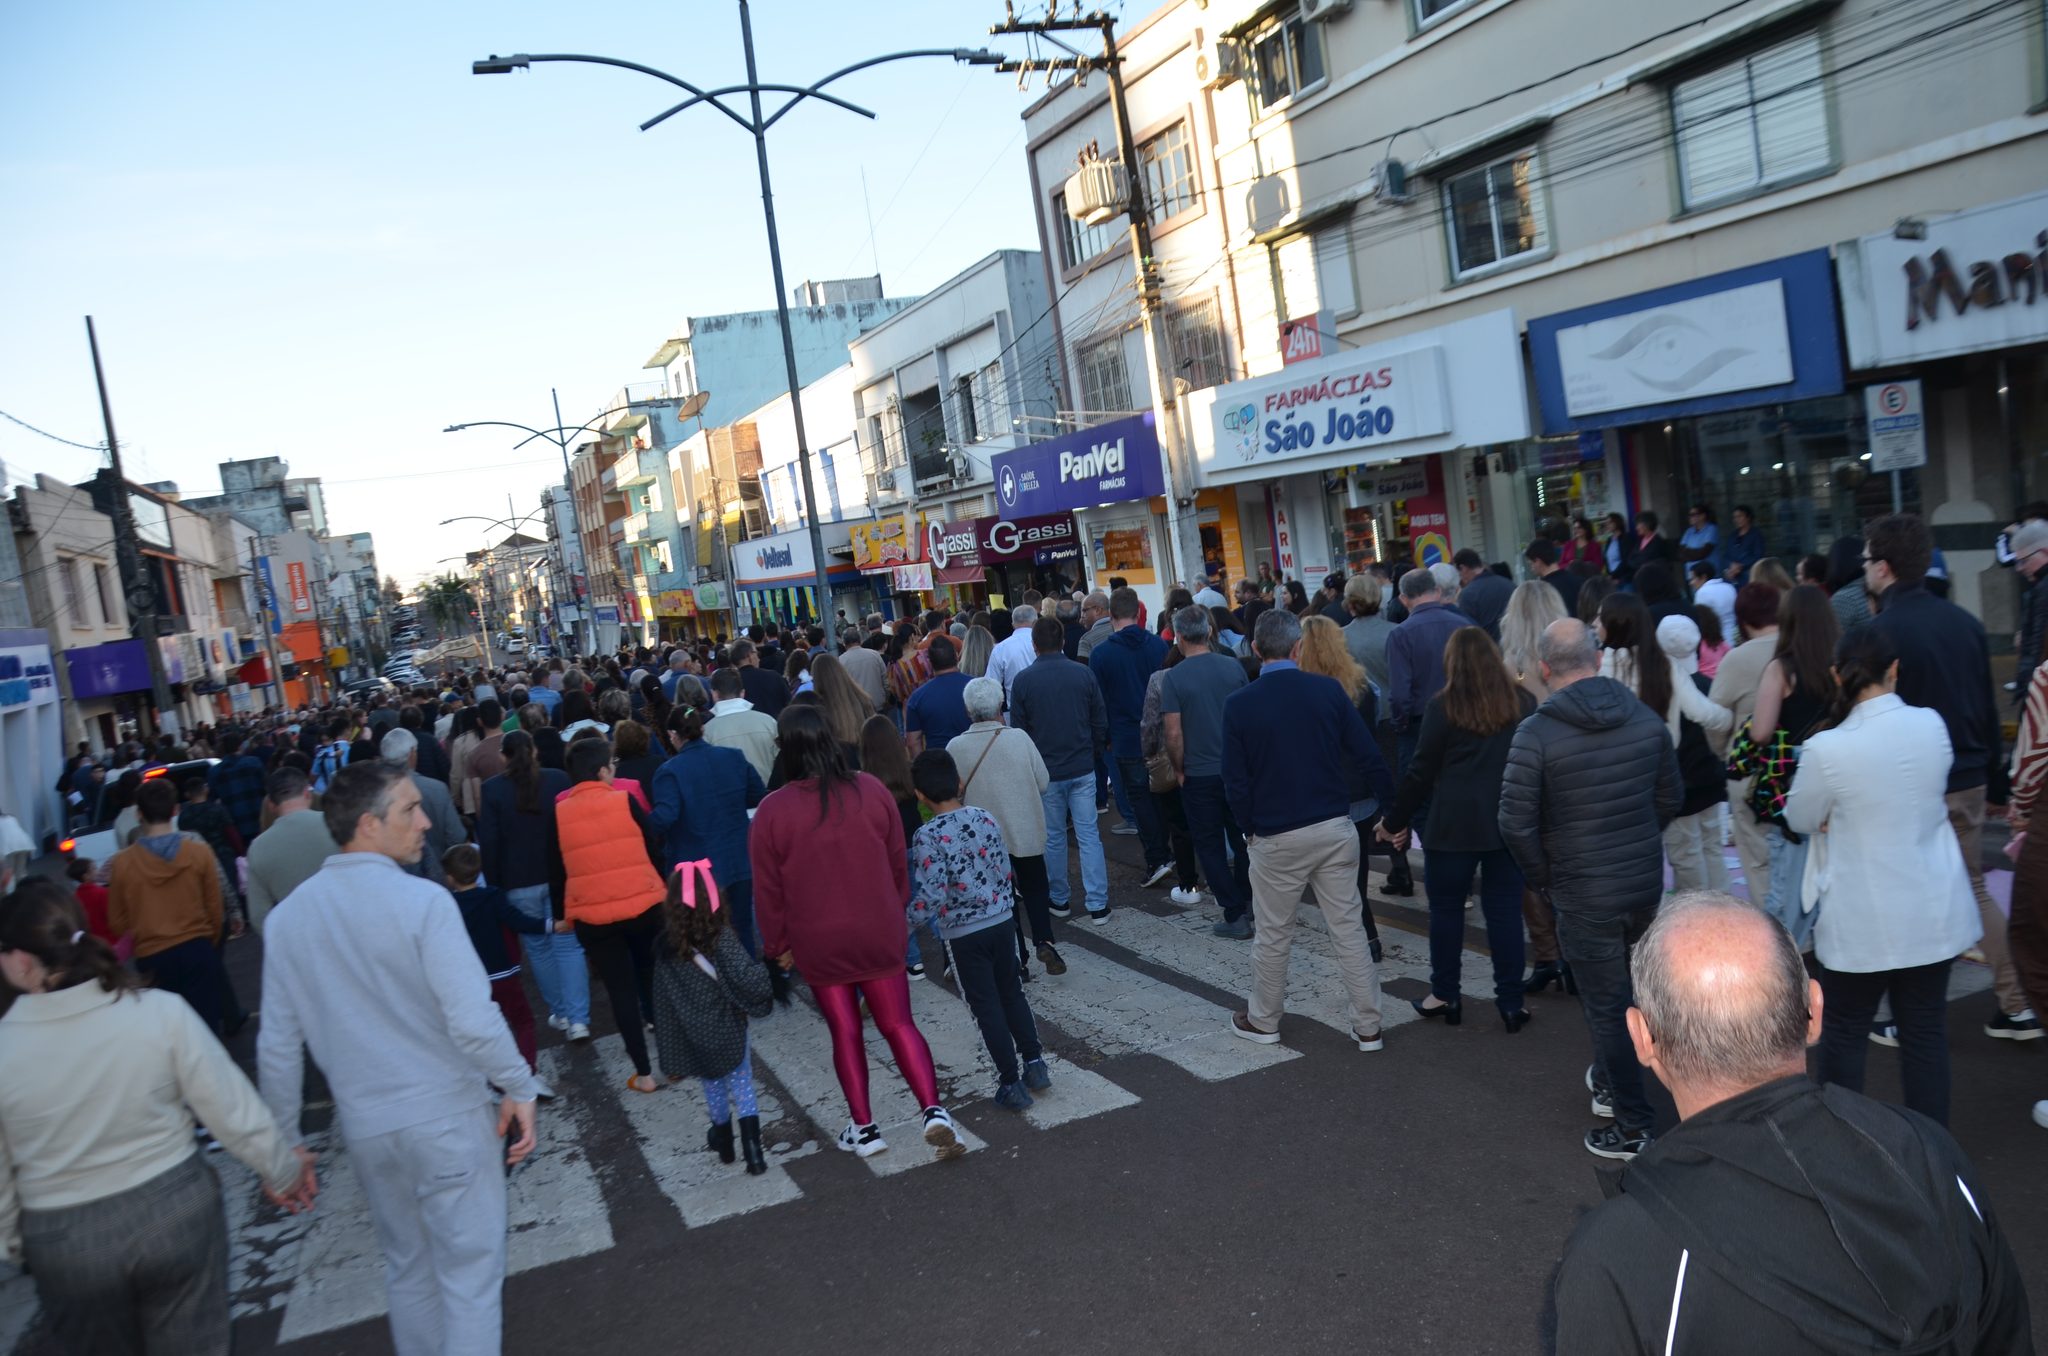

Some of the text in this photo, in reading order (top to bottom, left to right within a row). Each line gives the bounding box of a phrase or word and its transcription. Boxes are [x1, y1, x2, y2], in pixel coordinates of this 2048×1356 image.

[1286, 322, 1317, 359] 24h
[1264, 367, 1393, 413] FARMÁCIAS
[1264, 395, 1394, 454] São João
[1059, 437, 1125, 484] PanVel
[1099, 476, 1126, 491] FARMÁCIAS
[762, 543, 793, 570] Deltasul
[927, 520, 977, 570] Grassi
[982, 519, 1073, 554] Grassi
